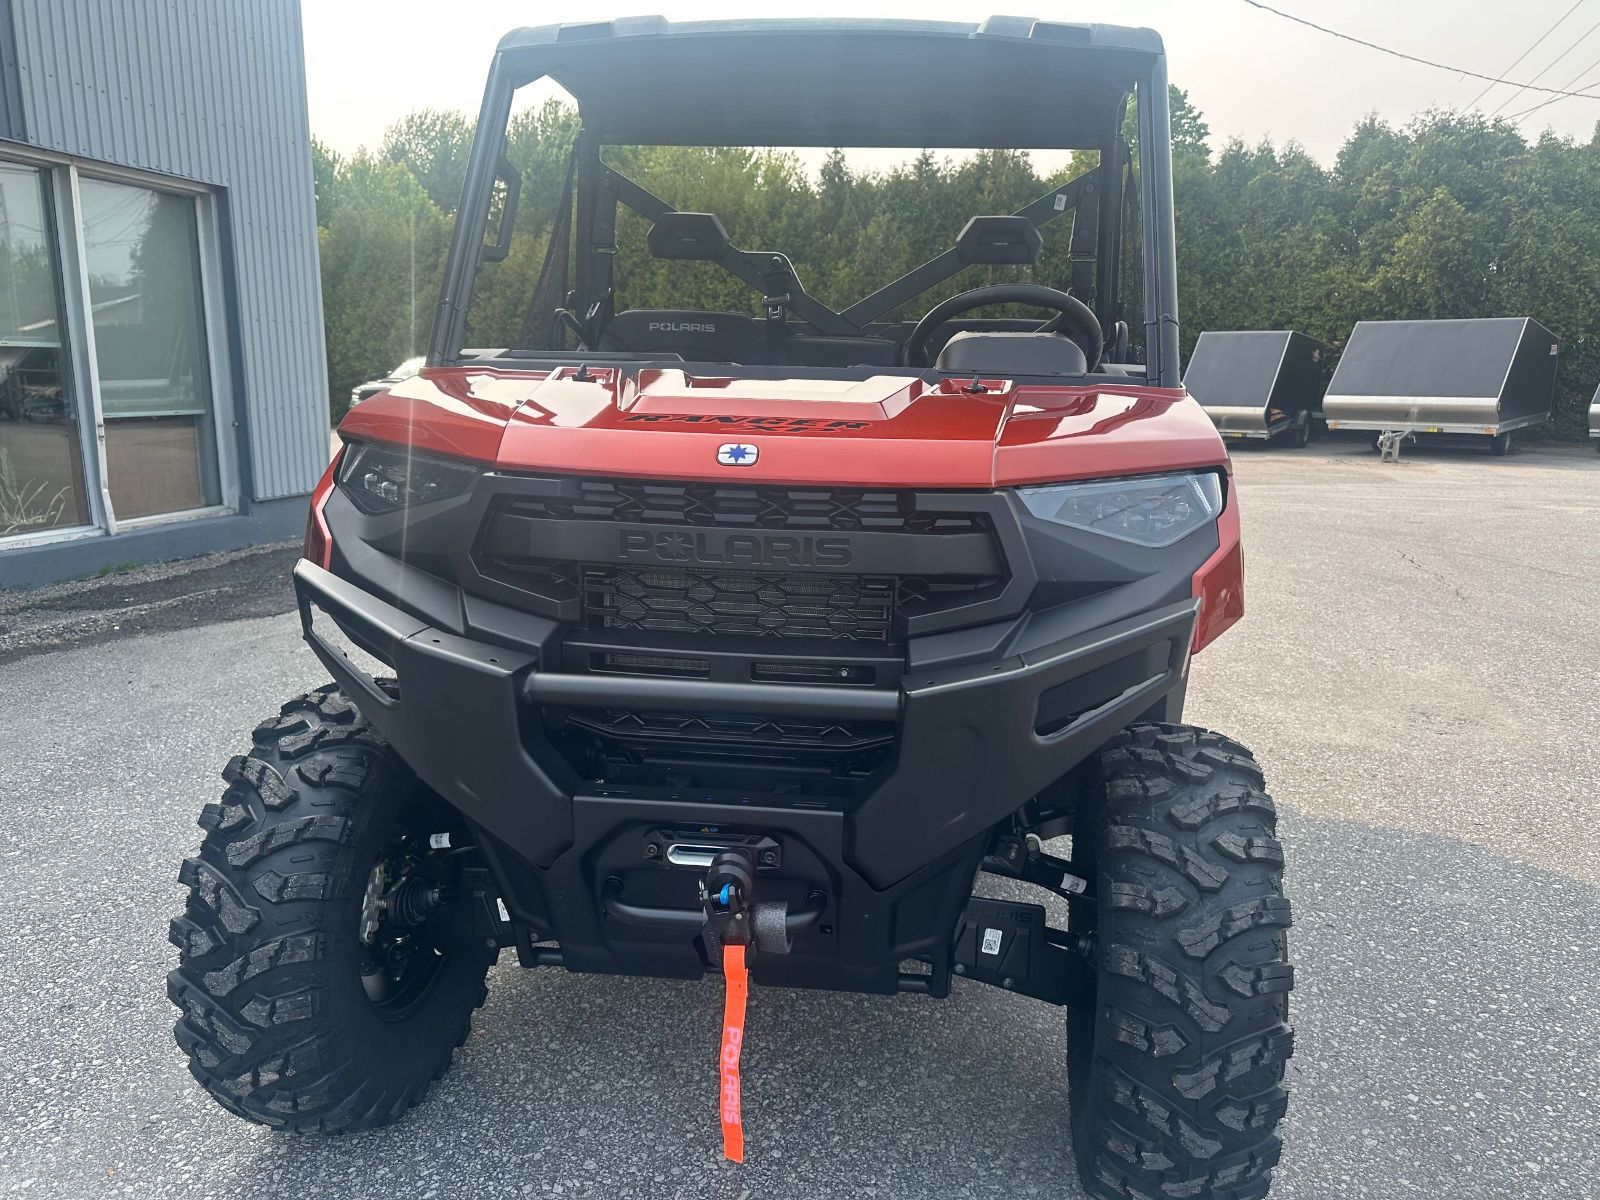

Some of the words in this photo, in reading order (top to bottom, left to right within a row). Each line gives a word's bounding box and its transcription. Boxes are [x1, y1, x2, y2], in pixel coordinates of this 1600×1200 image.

[648, 322, 716, 333] POLARIS
[619, 414, 874, 429] RANGER
[619, 529, 854, 568] POLARIS
[723, 1026, 741, 1125] POLARIS
